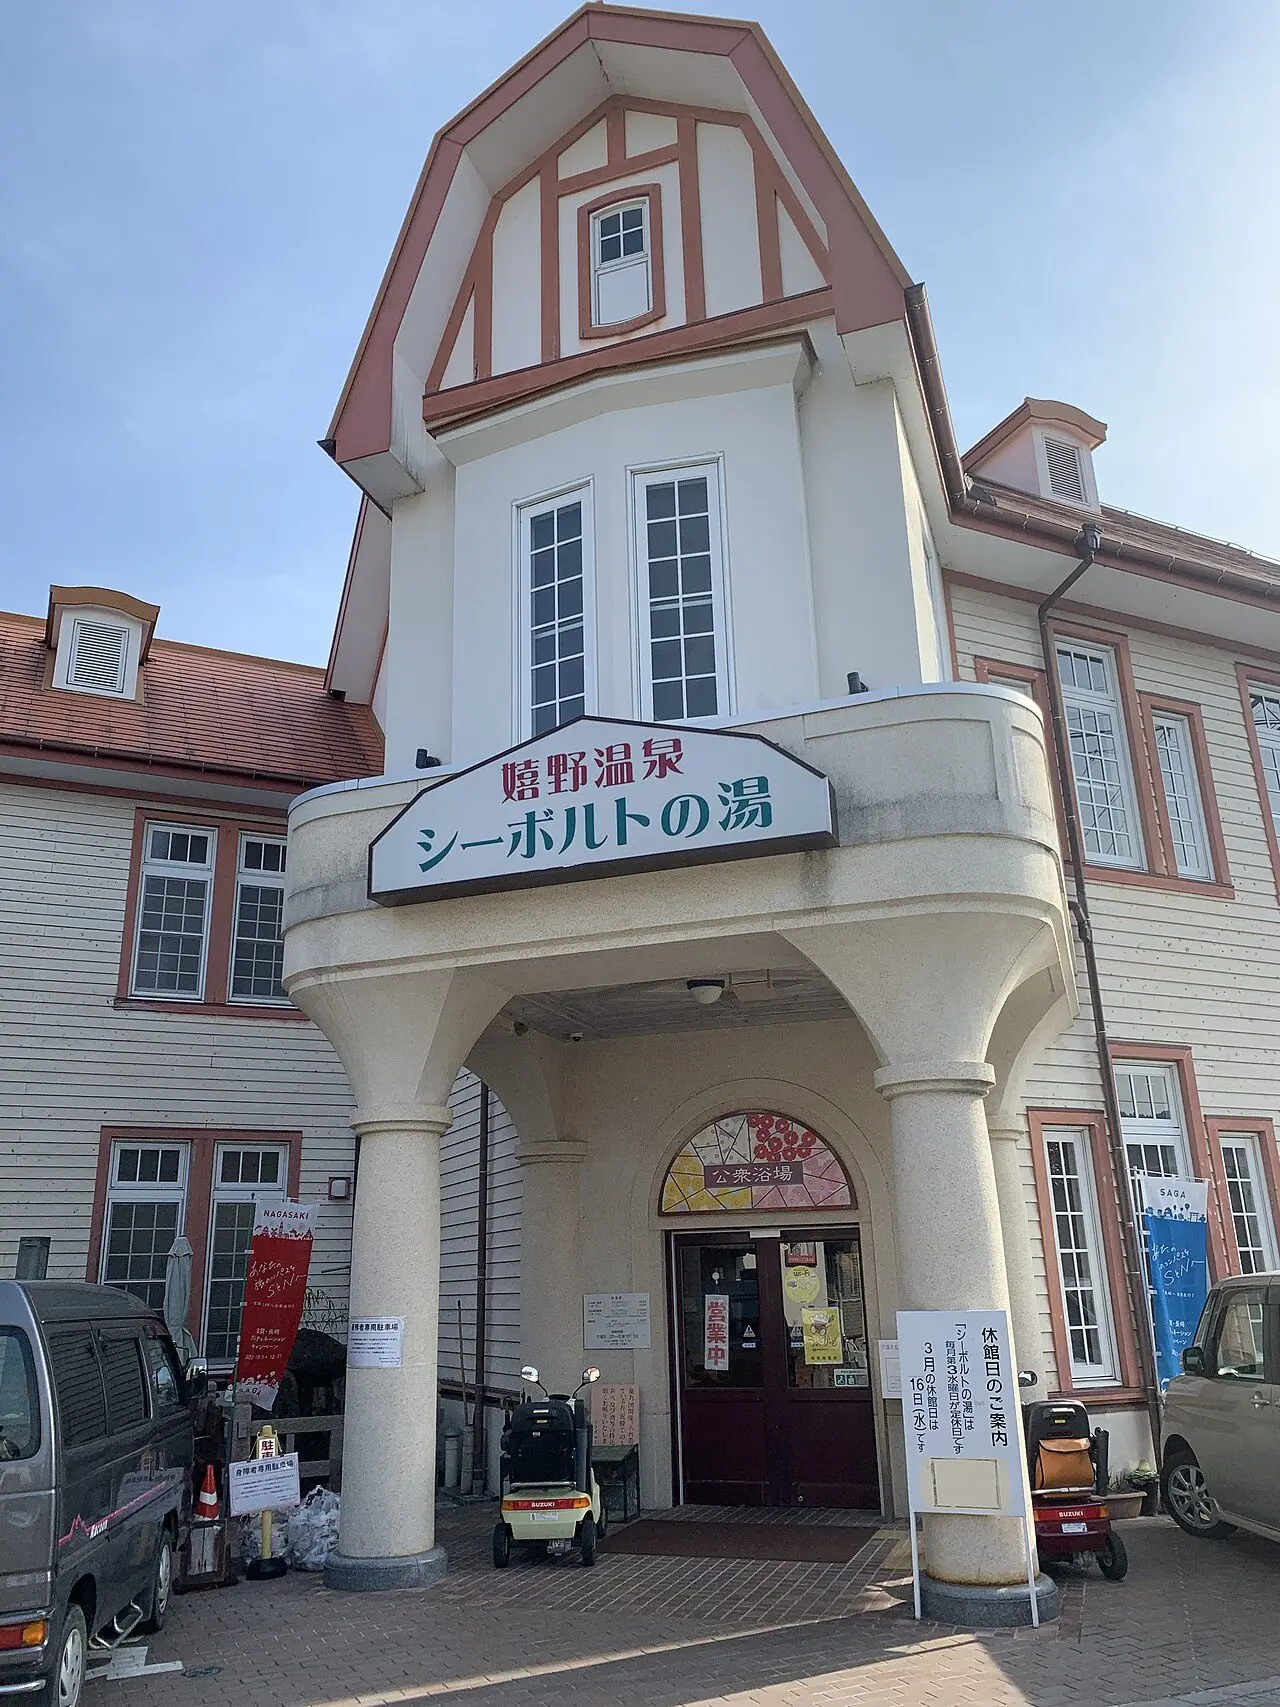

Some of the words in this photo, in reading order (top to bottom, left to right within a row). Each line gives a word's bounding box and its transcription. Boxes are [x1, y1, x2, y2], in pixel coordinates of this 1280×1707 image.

[502, 738, 684, 804] 嬉野温泉
[416, 776, 772, 872] シーボルトの湯
[712, 1165, 793, 1184] 公衆浴場
[1160, 1188, 1186, 1199] SAGA
[263, 1210, 309, 1220] NAGASAKI
[707, 1301, 727, 1366] 営業中
[923, 1342, 939, 1431] 3月の休館日は
[945, 1340, 965, 1455] 毎月第3水曜日が定休日です
[954, 1323, 975, 1431] 「シーボルトの湯」は
[981, 1327, 1008, 1447] 休館日のご案内
[1058, 1510, 1084, 1518] SUZUKI
